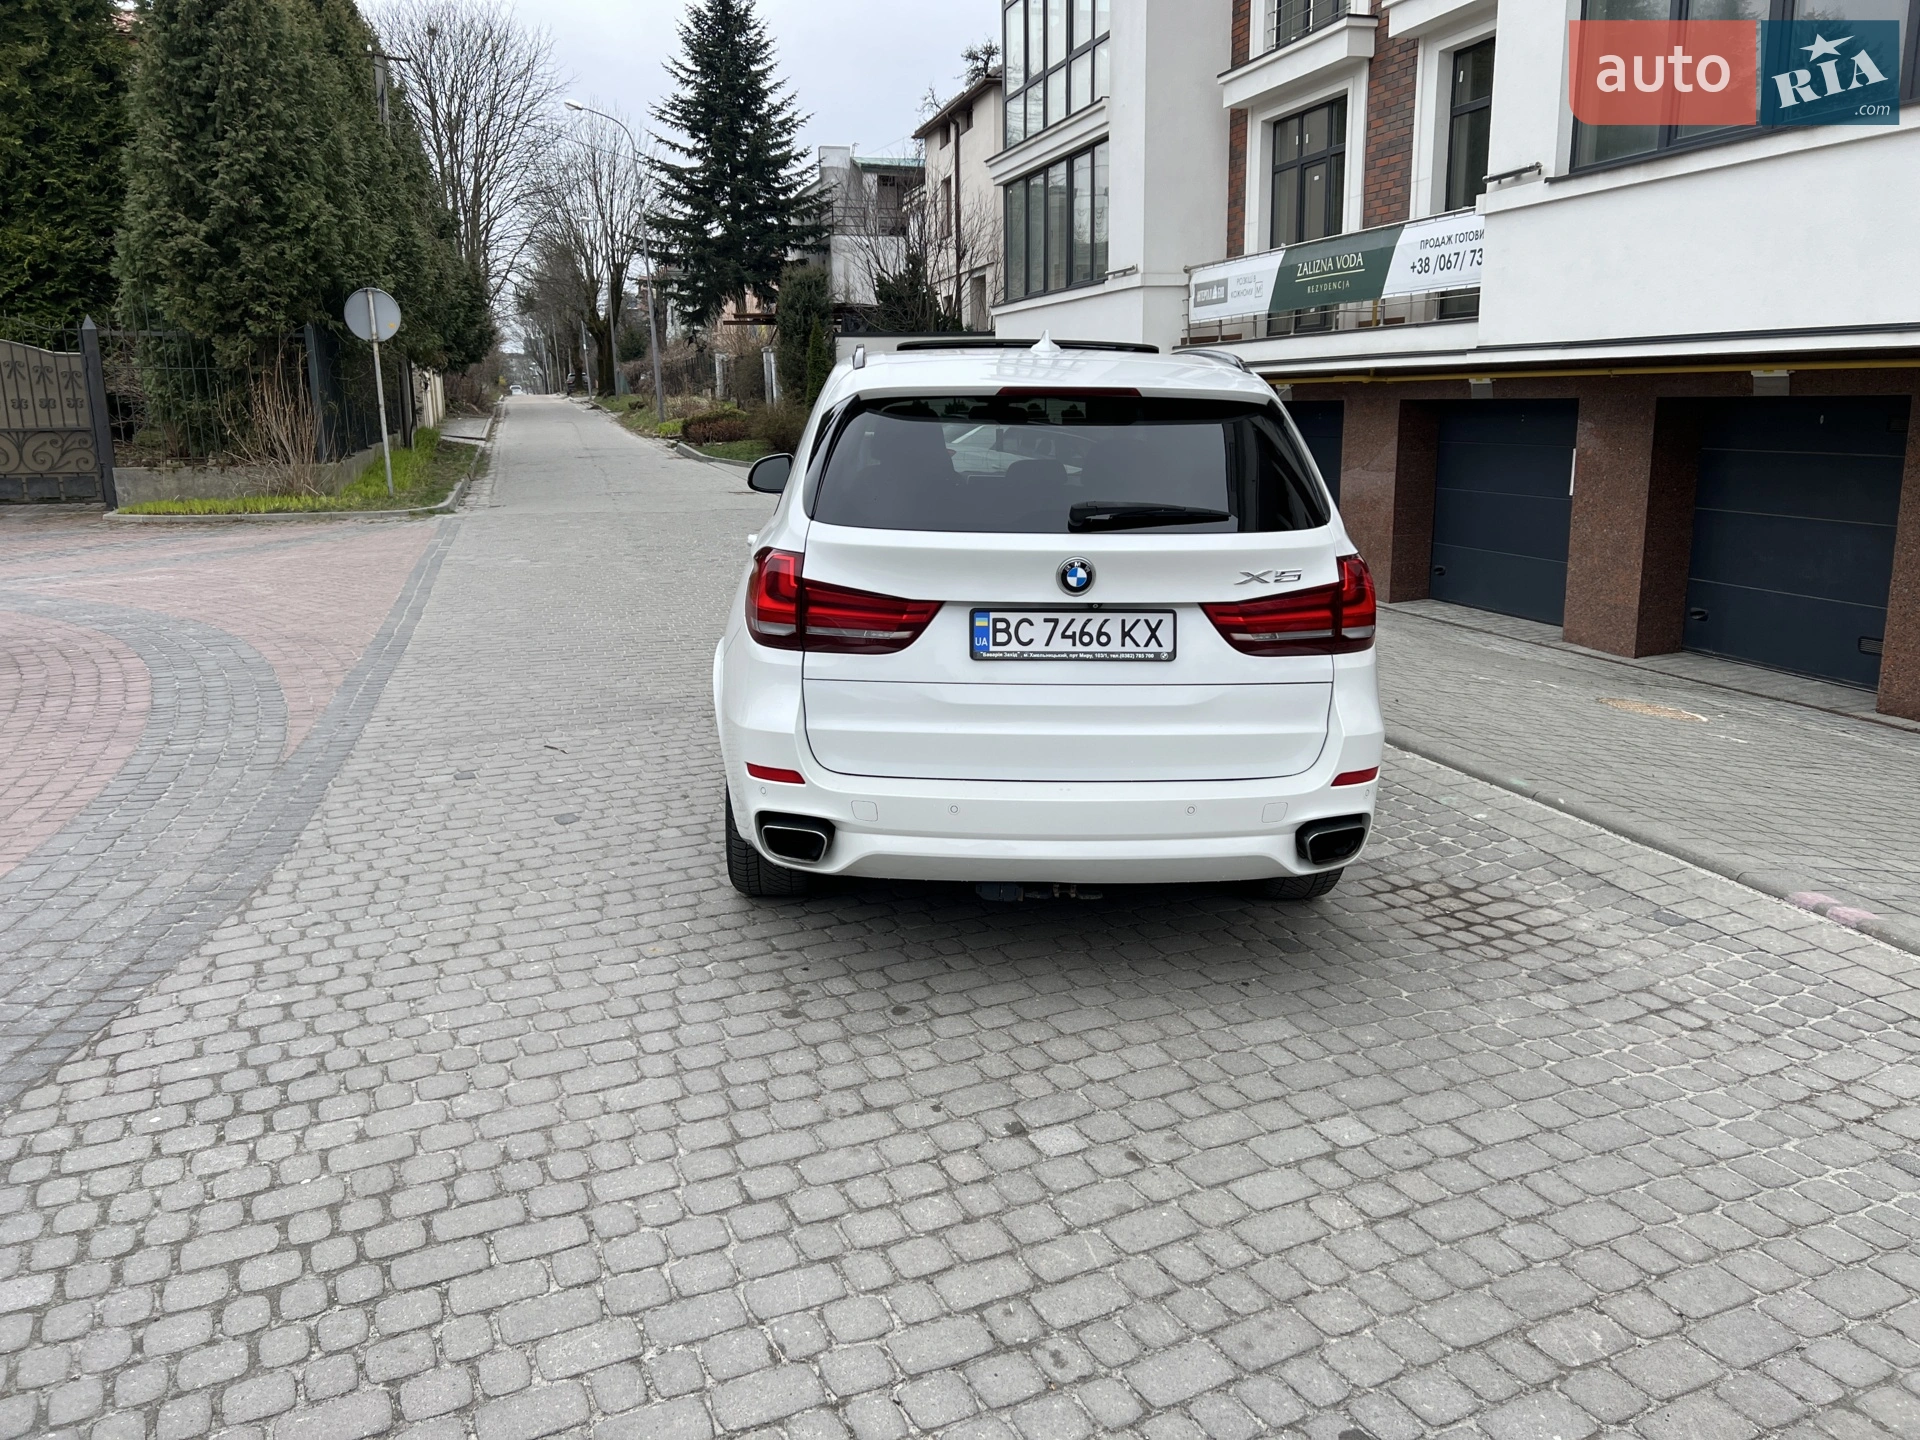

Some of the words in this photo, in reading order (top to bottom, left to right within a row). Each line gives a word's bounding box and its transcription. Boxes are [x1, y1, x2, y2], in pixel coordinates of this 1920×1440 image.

[1420, 234, 1453, 250] ПРОДАЖ
[1297, 257, 1334, 277] ZALIZNA
[1336, 252, 1364, 270] VODA
[1410, 256, 1430, 275] +38
[1307, 280, 1350, 294] REZYDENCJA
[1234, 568, 1303, 586] X5
[975, 637, 988, 646] UA
[992, 617, 1035, 647] BC
[1043, 618, 1112, 647] 7466
[1120, 618, 1164, 648] KX
